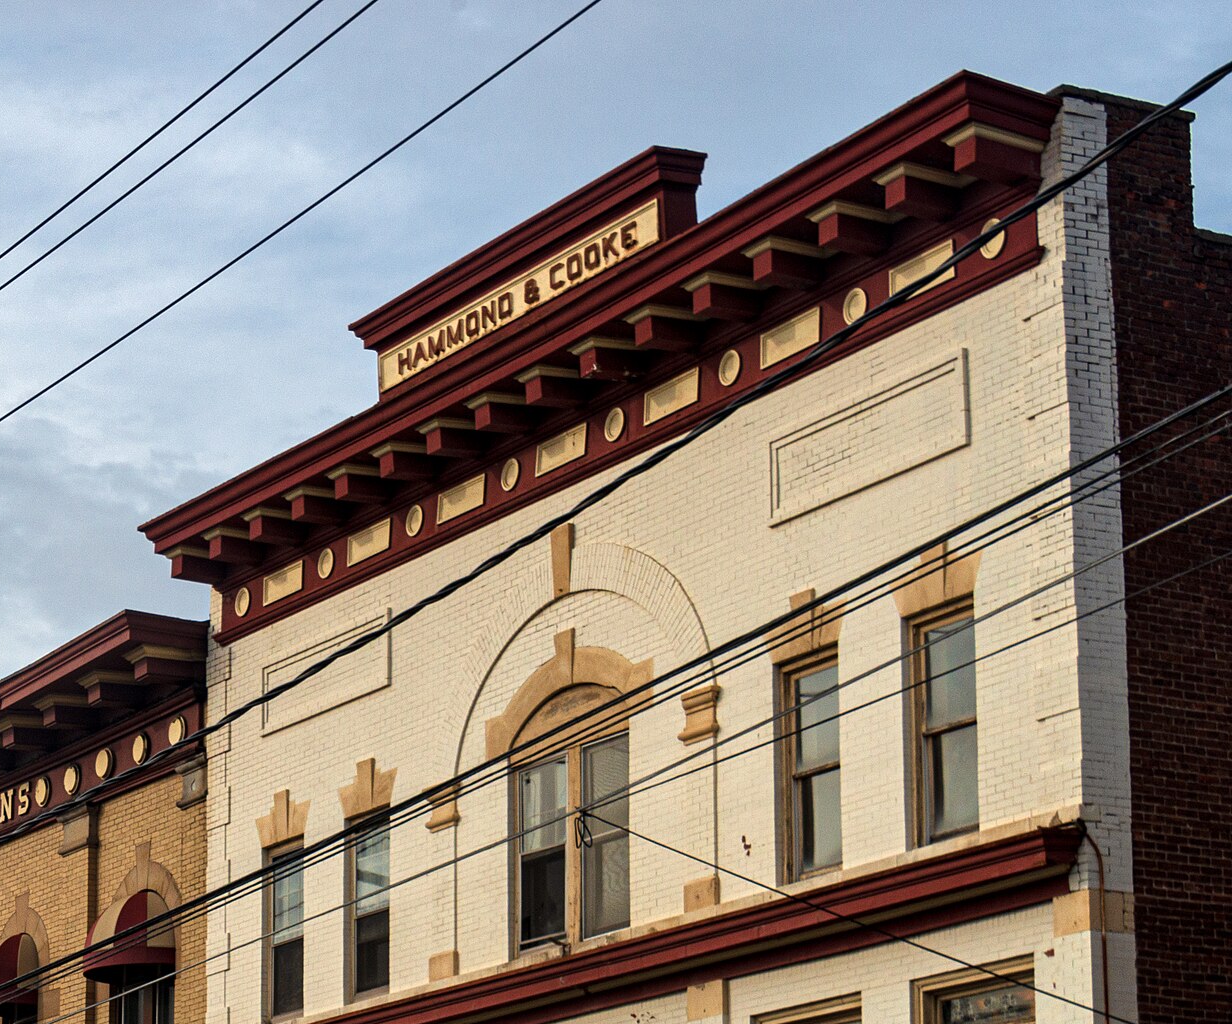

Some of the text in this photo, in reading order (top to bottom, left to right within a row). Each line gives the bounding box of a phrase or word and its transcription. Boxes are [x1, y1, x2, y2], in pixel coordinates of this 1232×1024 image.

[397, 220, 639, 376] HAMMOND & COOKE
